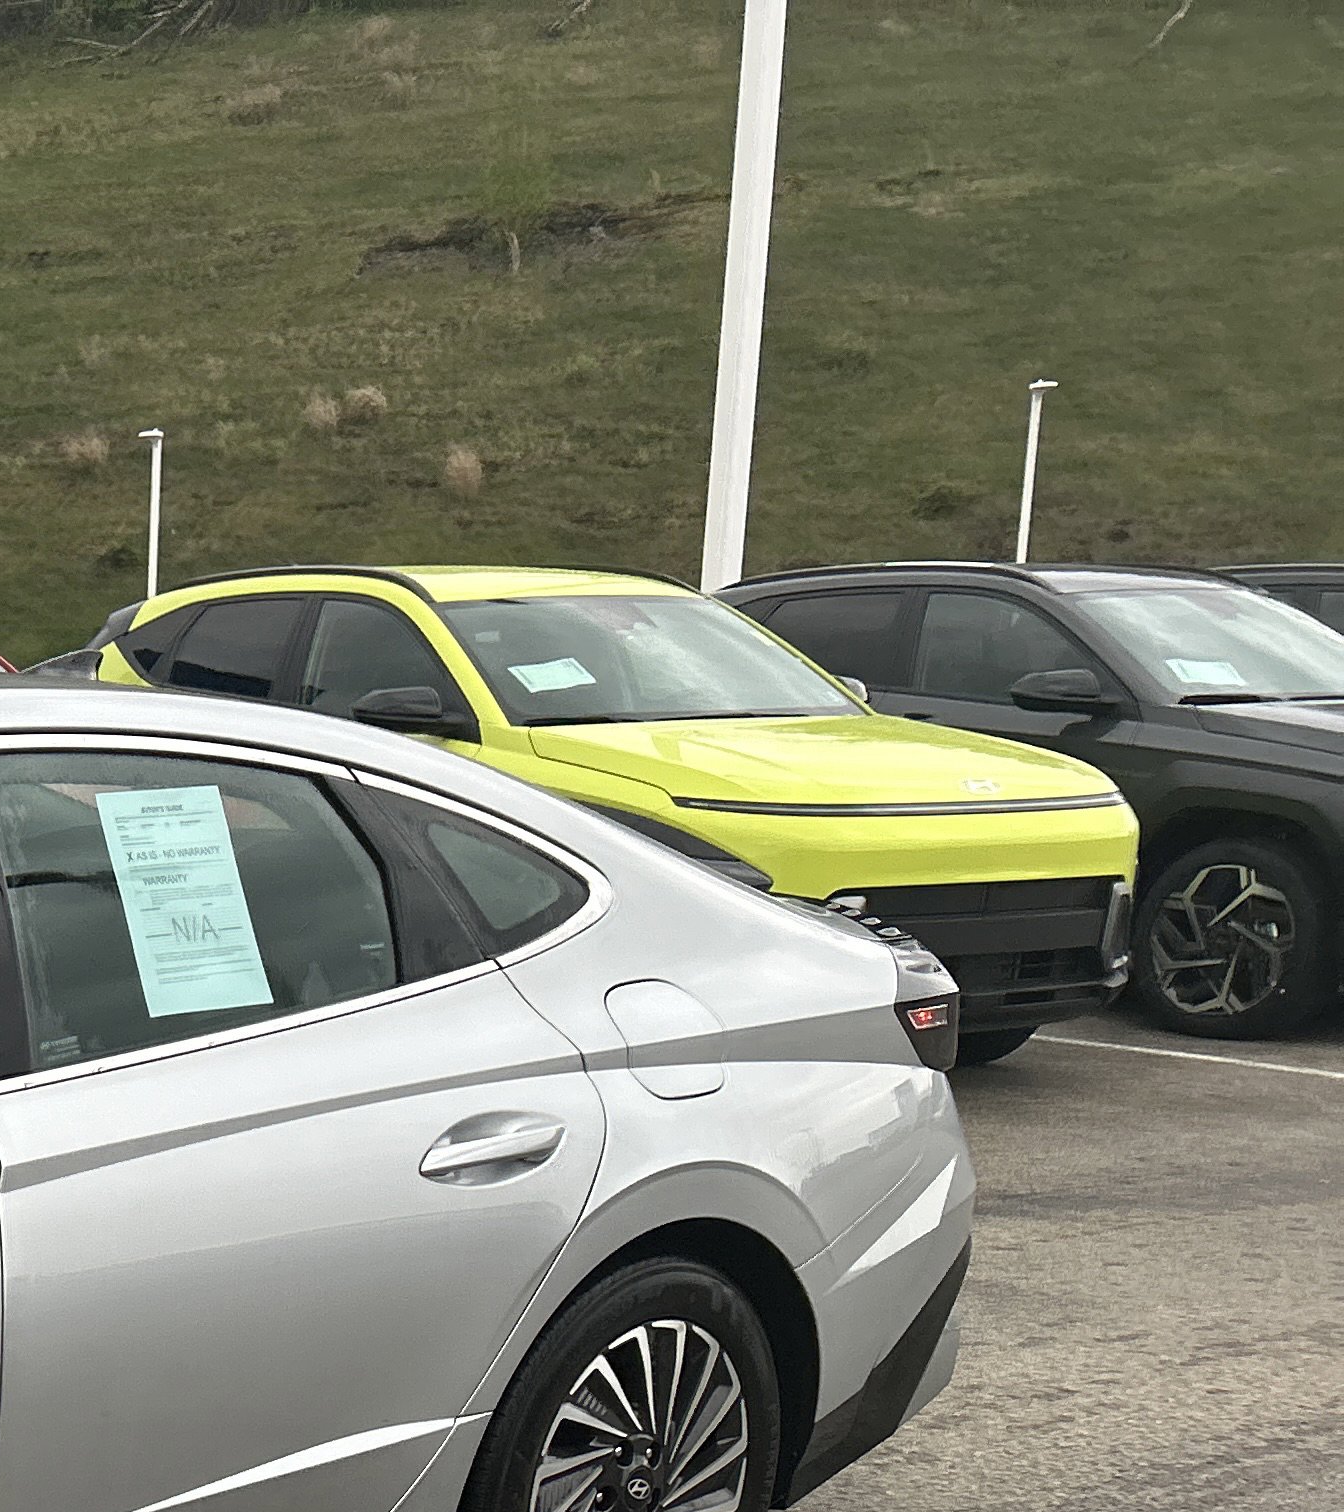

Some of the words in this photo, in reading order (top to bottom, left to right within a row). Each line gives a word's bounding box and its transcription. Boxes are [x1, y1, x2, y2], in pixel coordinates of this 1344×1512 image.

[137, 851, 148, 861] AS
[163, 848, 176, 859] NO
[177, 845, 221, 857] WARRANTY
[142, 873, 188, 886] WARRANTY
[171, 913, 221, 943] N/A
